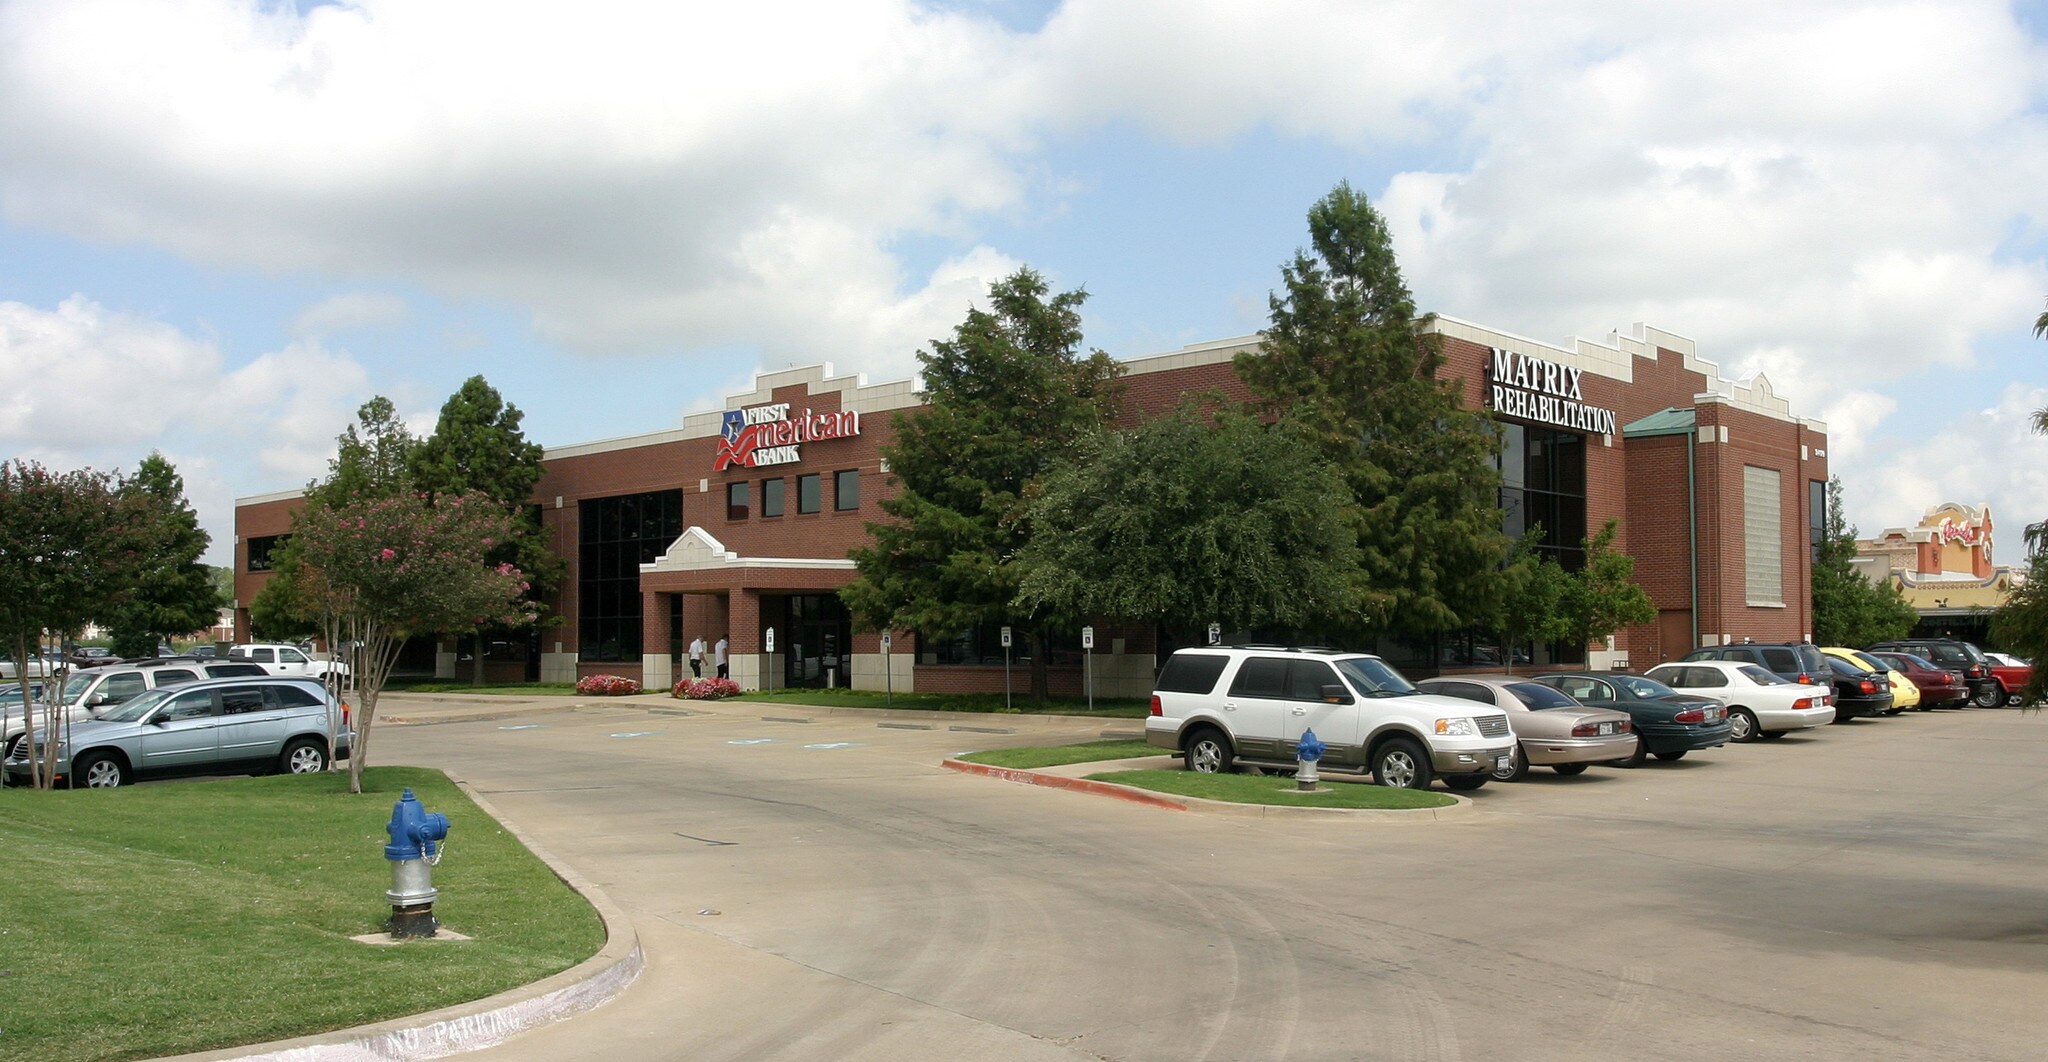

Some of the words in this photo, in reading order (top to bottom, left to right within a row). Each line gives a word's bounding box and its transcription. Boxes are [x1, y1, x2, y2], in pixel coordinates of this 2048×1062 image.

[1492, 347, 1583, 401] MATRIX
[746, 403, 790, 425] FIRST
[1492, 384, 1616, 436] REHABILITATION
[756, 444, 801, 466] BANK
[386, 1027, 420, 1051] NO
[433, 1007, 521, 1046] PARKING
